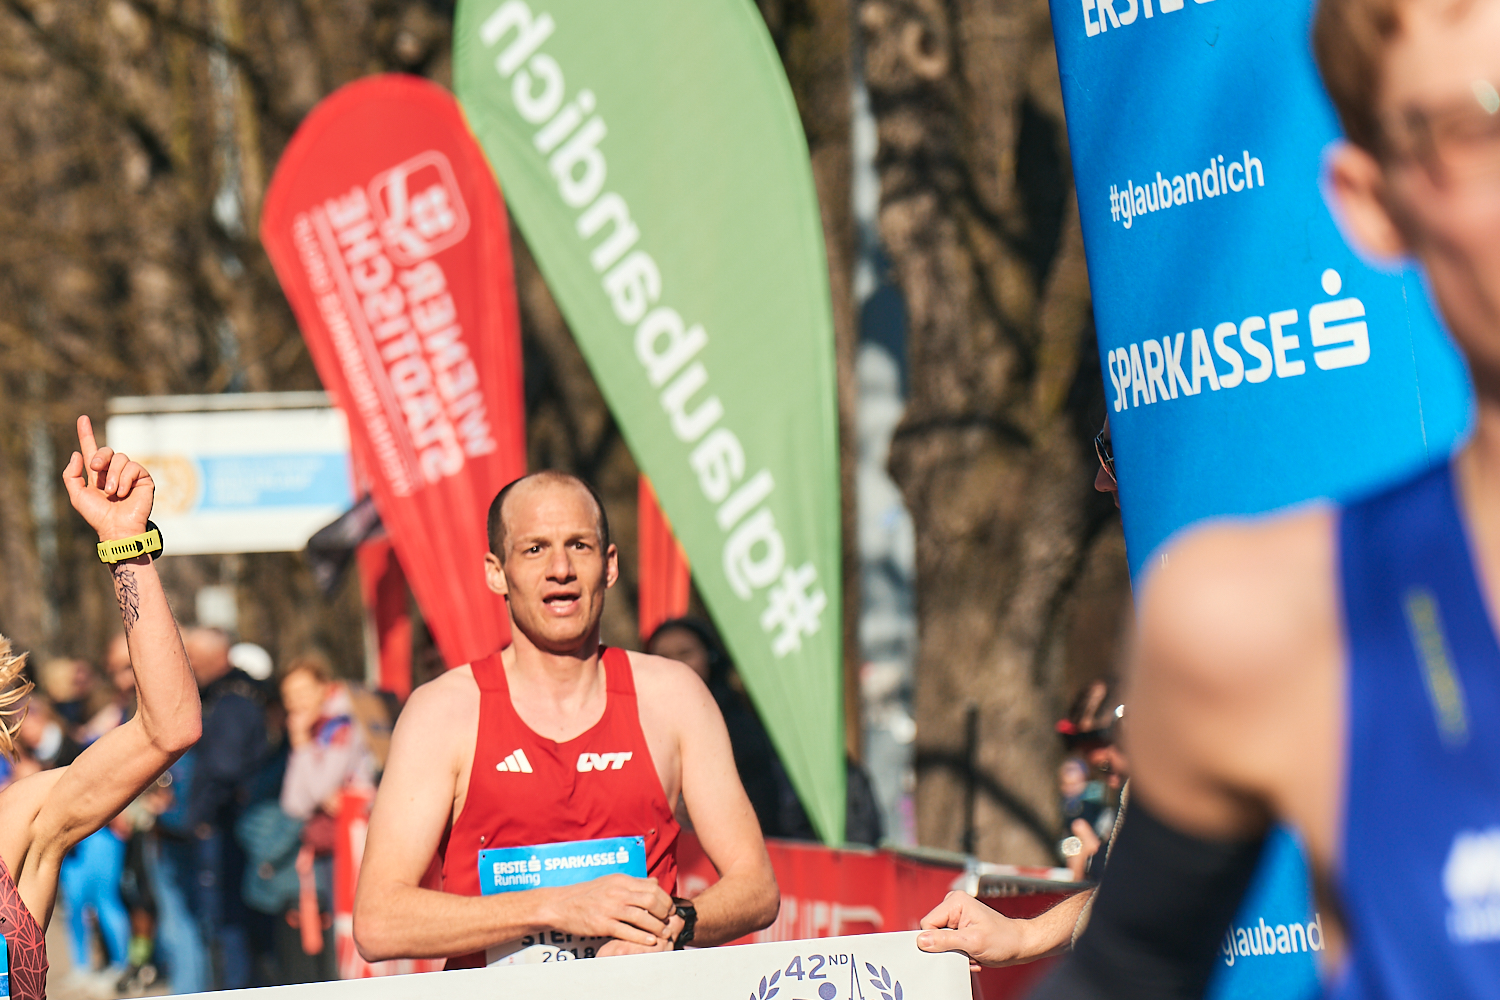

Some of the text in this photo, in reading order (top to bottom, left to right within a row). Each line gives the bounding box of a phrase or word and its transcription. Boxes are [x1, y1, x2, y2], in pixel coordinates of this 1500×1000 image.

[1109, 149, 1265, 230] #glaubandich
[1108, 309, 1306, 413] SPARKASSE
[493, 854, 615, 875] ERSTE SPARKASSE
[493, 872, 541, 887] Running
